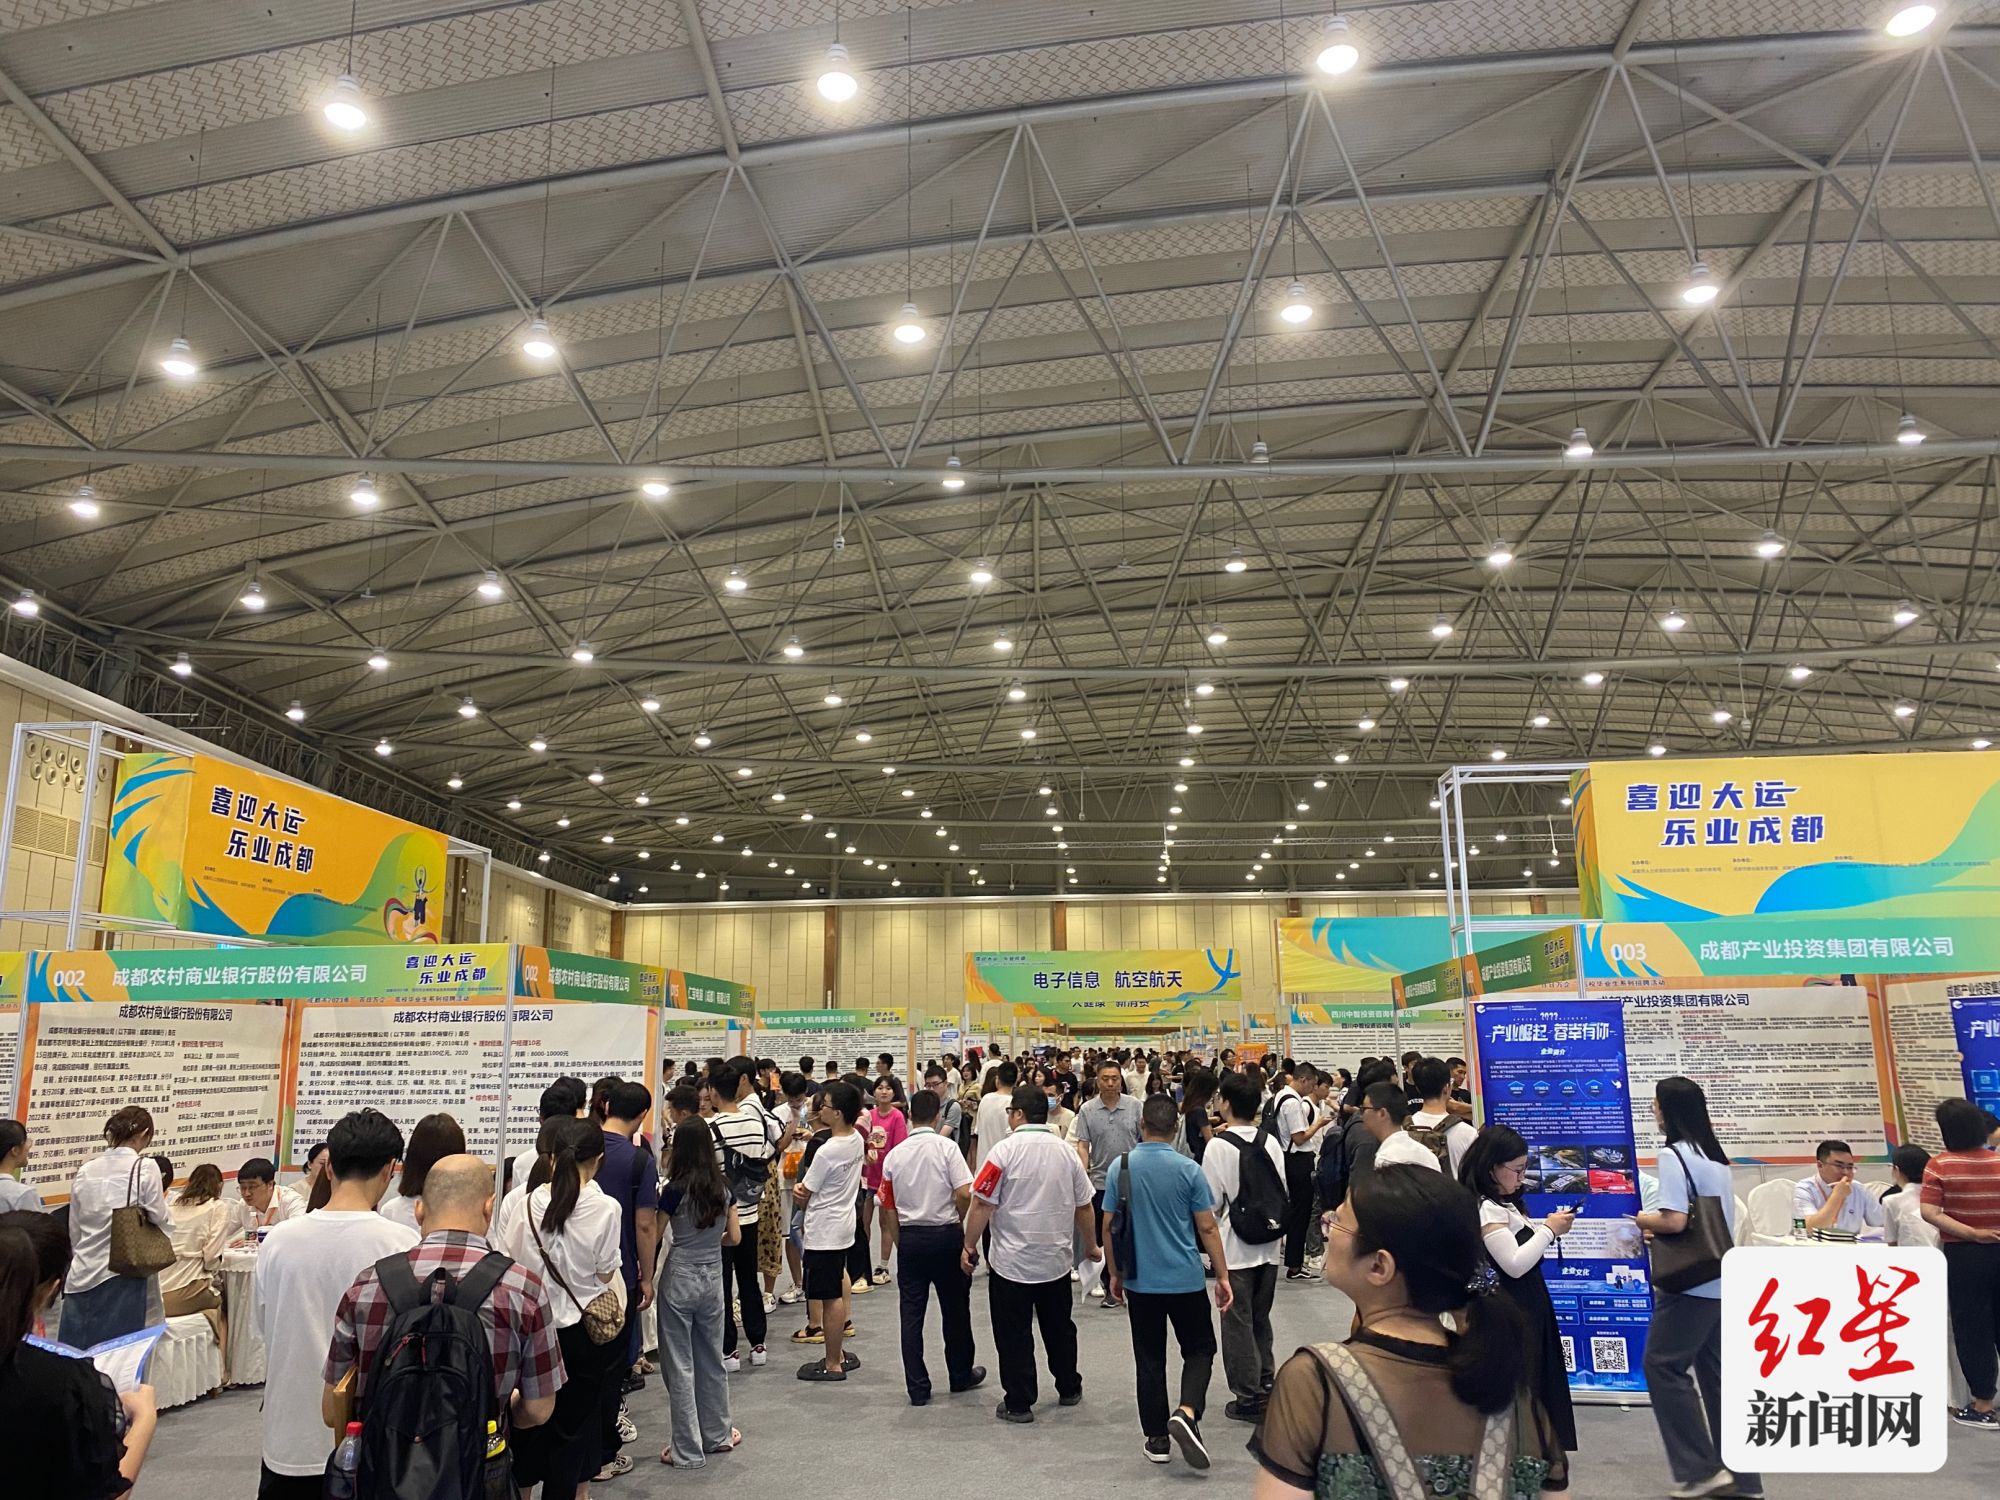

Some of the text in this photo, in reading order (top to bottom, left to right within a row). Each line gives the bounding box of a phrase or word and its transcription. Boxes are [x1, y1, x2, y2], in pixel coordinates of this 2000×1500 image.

[1626, 780, 1798, 811] 喜迎大运
[210, 785, 306, 836] 喜迎大运
[1660, 815, 1825, 847] 乐业成都
[224, 828, 315, 873] 乐业成都
[1609, 935, 1955, 961] 003 成都产业投资集团有限公司
[405, 952, 478, 970] 喜迎大运
[53, 963, 368, 988] 002 成都农村商业银行股份有限公司
[418, 967, 487, 985] 乐业成都
[524, 964, 630, 993] 002 成都农村商业银行股份有限公司
[1032, 970, 1183, 989] 电子信息 航空航天
[118, 1004, 234, 1022] 成都农村商业银行股份有限公司
[1491, 1022, 1610, 1044] 产业崛起 蓉幸有你
